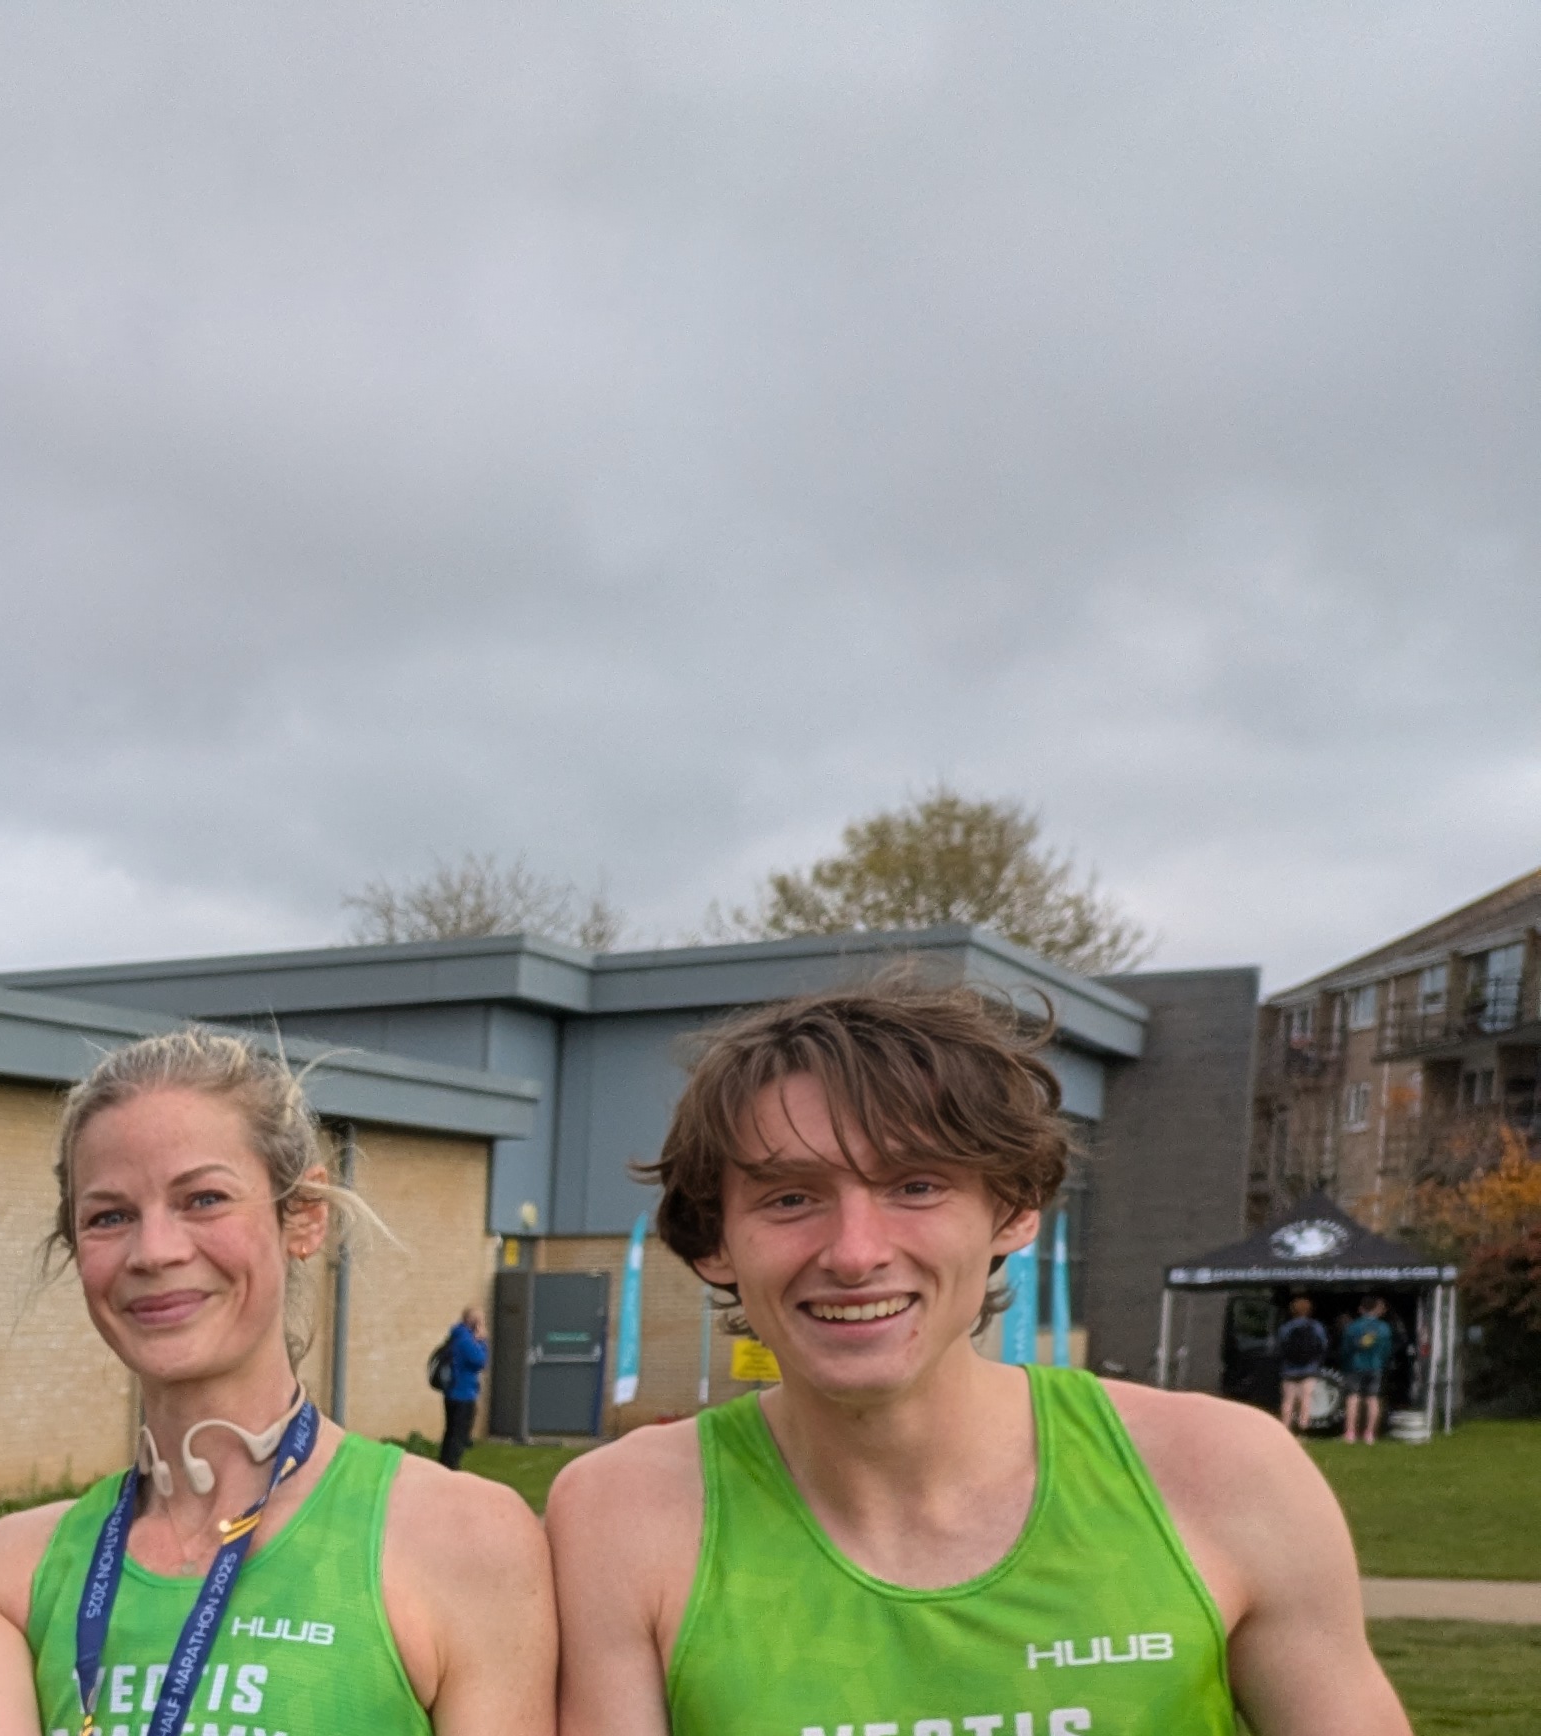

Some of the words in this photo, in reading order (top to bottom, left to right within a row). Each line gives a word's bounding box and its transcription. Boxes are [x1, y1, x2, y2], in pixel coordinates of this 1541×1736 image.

[176, 1597, 221, 1699] MARATHON
[211, 1552, 238, 1597] 2025
[231, 1616, 335, 1645] HUUB
[1027, 1633, 1173, 1670] HUUB
